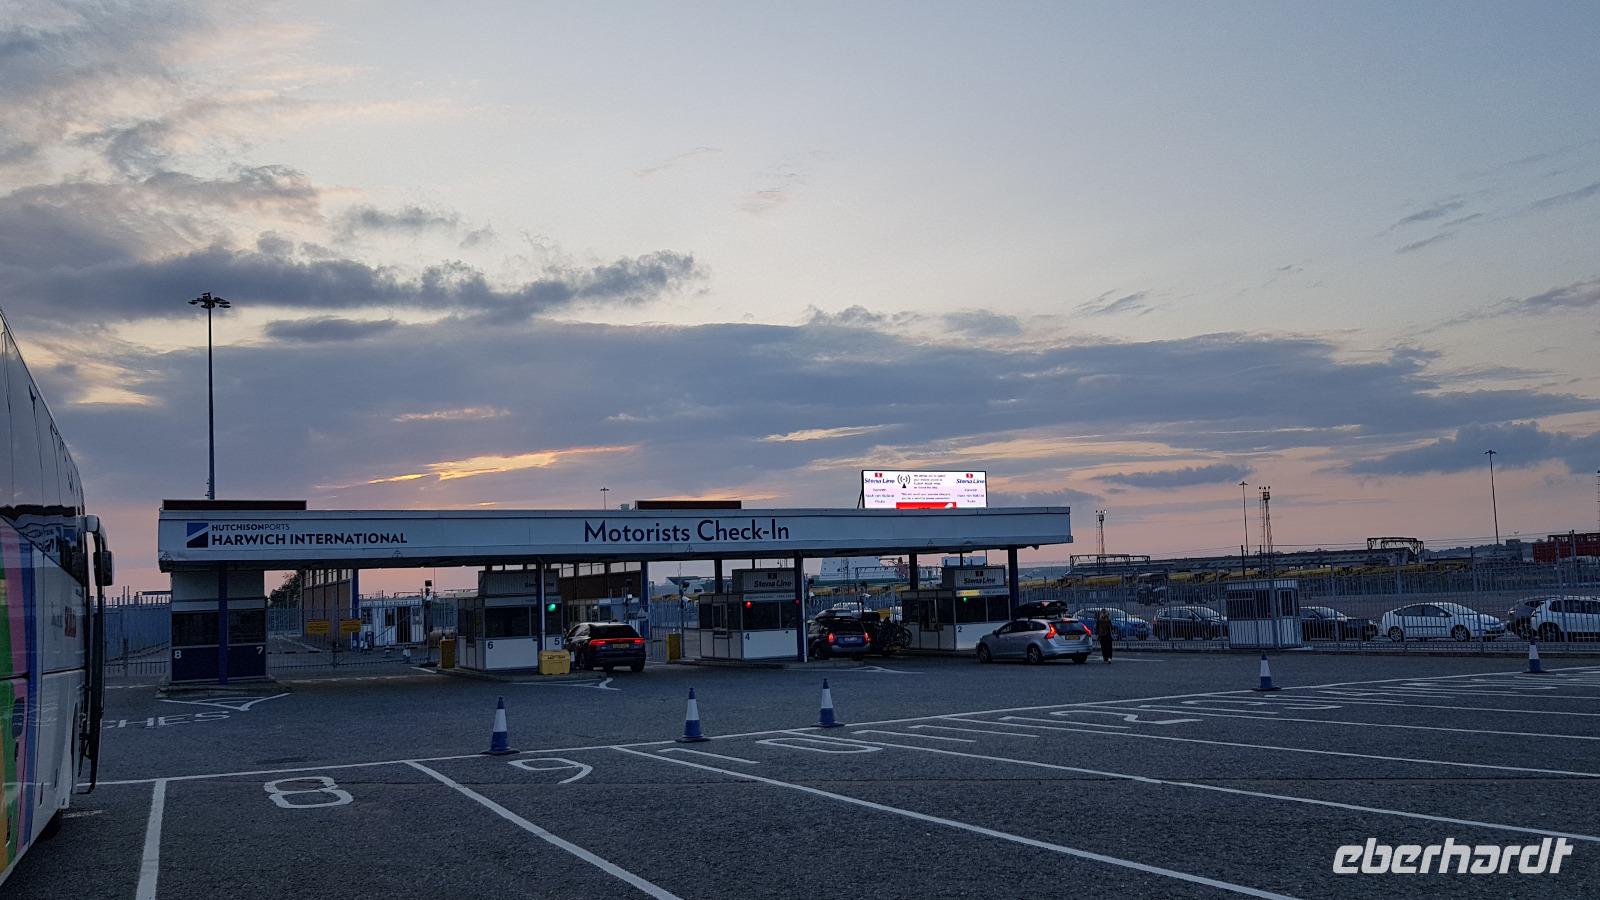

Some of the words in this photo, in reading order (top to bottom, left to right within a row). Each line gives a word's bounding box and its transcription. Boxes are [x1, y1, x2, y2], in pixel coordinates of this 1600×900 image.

[584, 520, 690, 543] Motorists
[697, 519, 790, 541] Check-In
[211, 534, 286, 546] HARWICH
[290, 533, 408, 545] INTERNATIONAL
[754, 580, 775, 588] Stena
[957, 625, 962, 633] 2
[487, 641, 494, 649] 6
[554, 637, 560, 646] 5
[174, 650, 182, 659] 8
[256, 646, 264, 654] 7
[656, 738, 882, 764] 10
[505, 757, 593, 785] 9
[263, 776, 354, 809] 8
